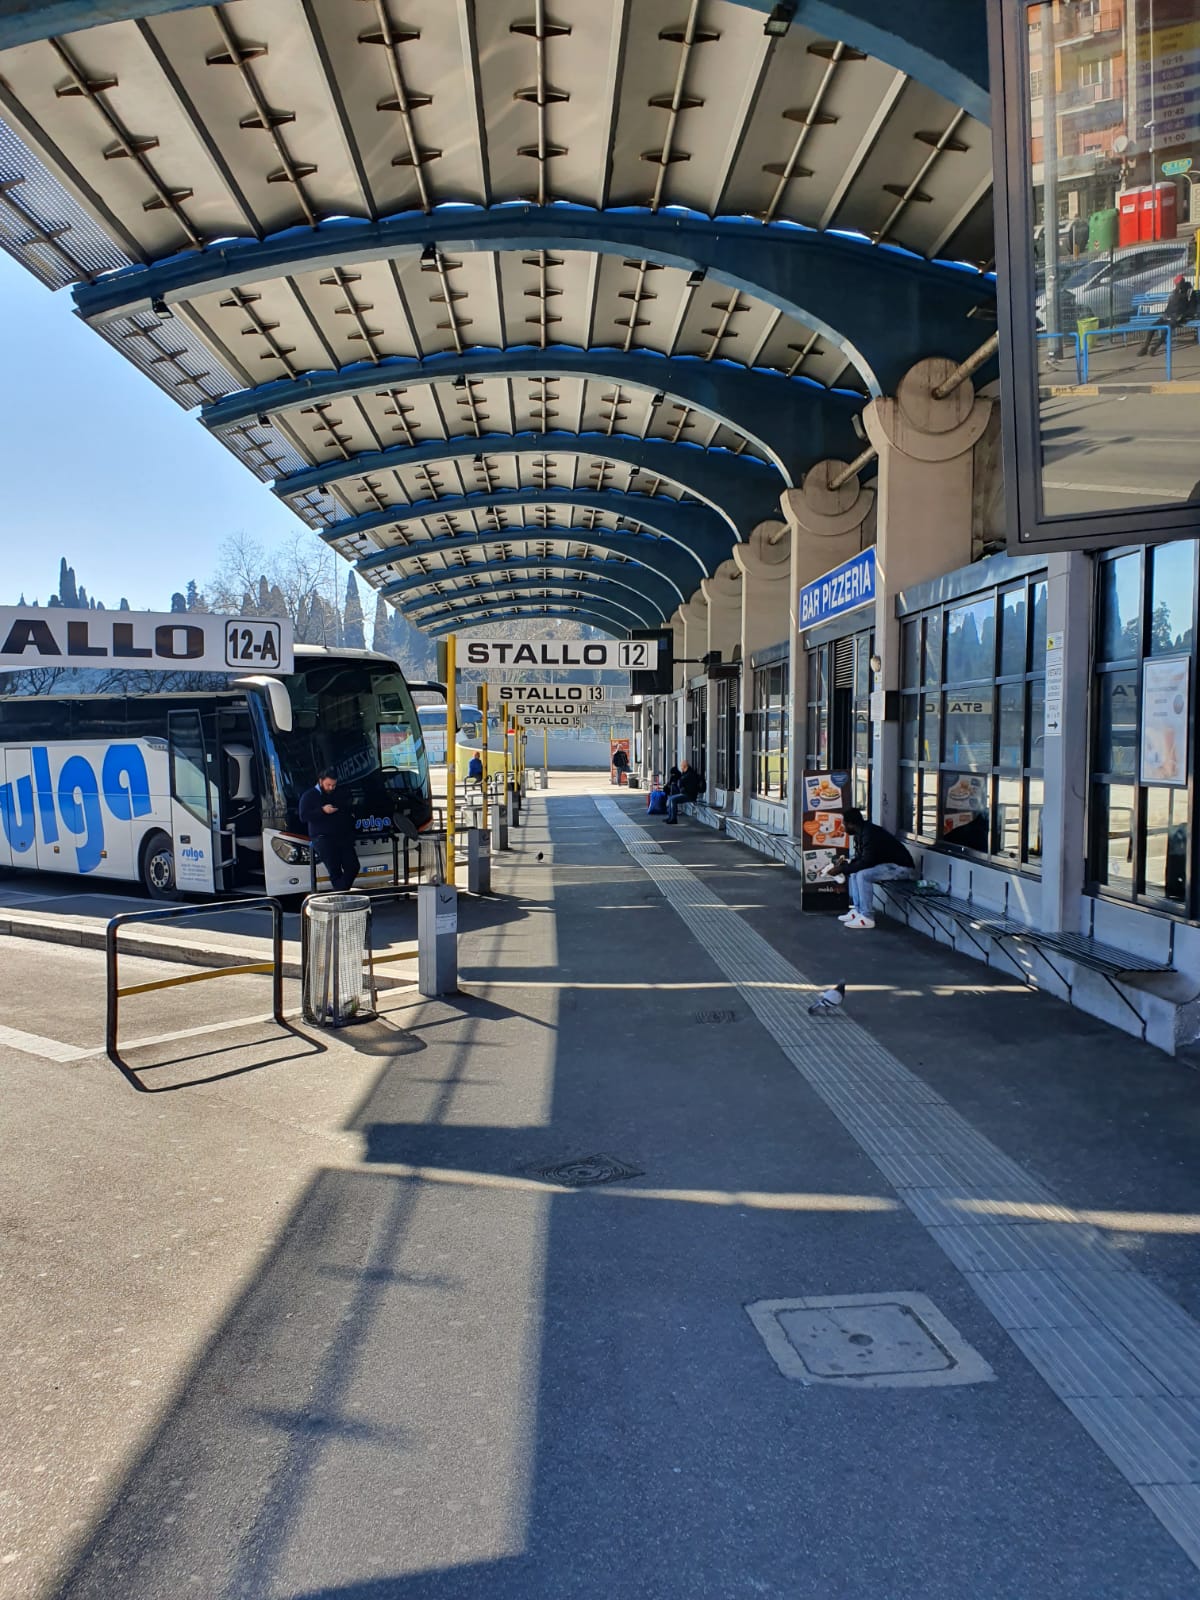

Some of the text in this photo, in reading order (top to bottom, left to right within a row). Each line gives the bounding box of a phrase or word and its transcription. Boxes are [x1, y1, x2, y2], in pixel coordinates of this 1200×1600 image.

[802, 560, 869, 621] BAR PIZZERIA
[1, 619, 278, 661] ALLO 12-A
[467, 643, 645, 666] STALLO 12
[500, 686, 603, 700] STALLO 13
[516, 705, 589, 715] STALLO 14
[524, 717, 569, 725] STALLO
[0, 744, 152, 873] ulga
